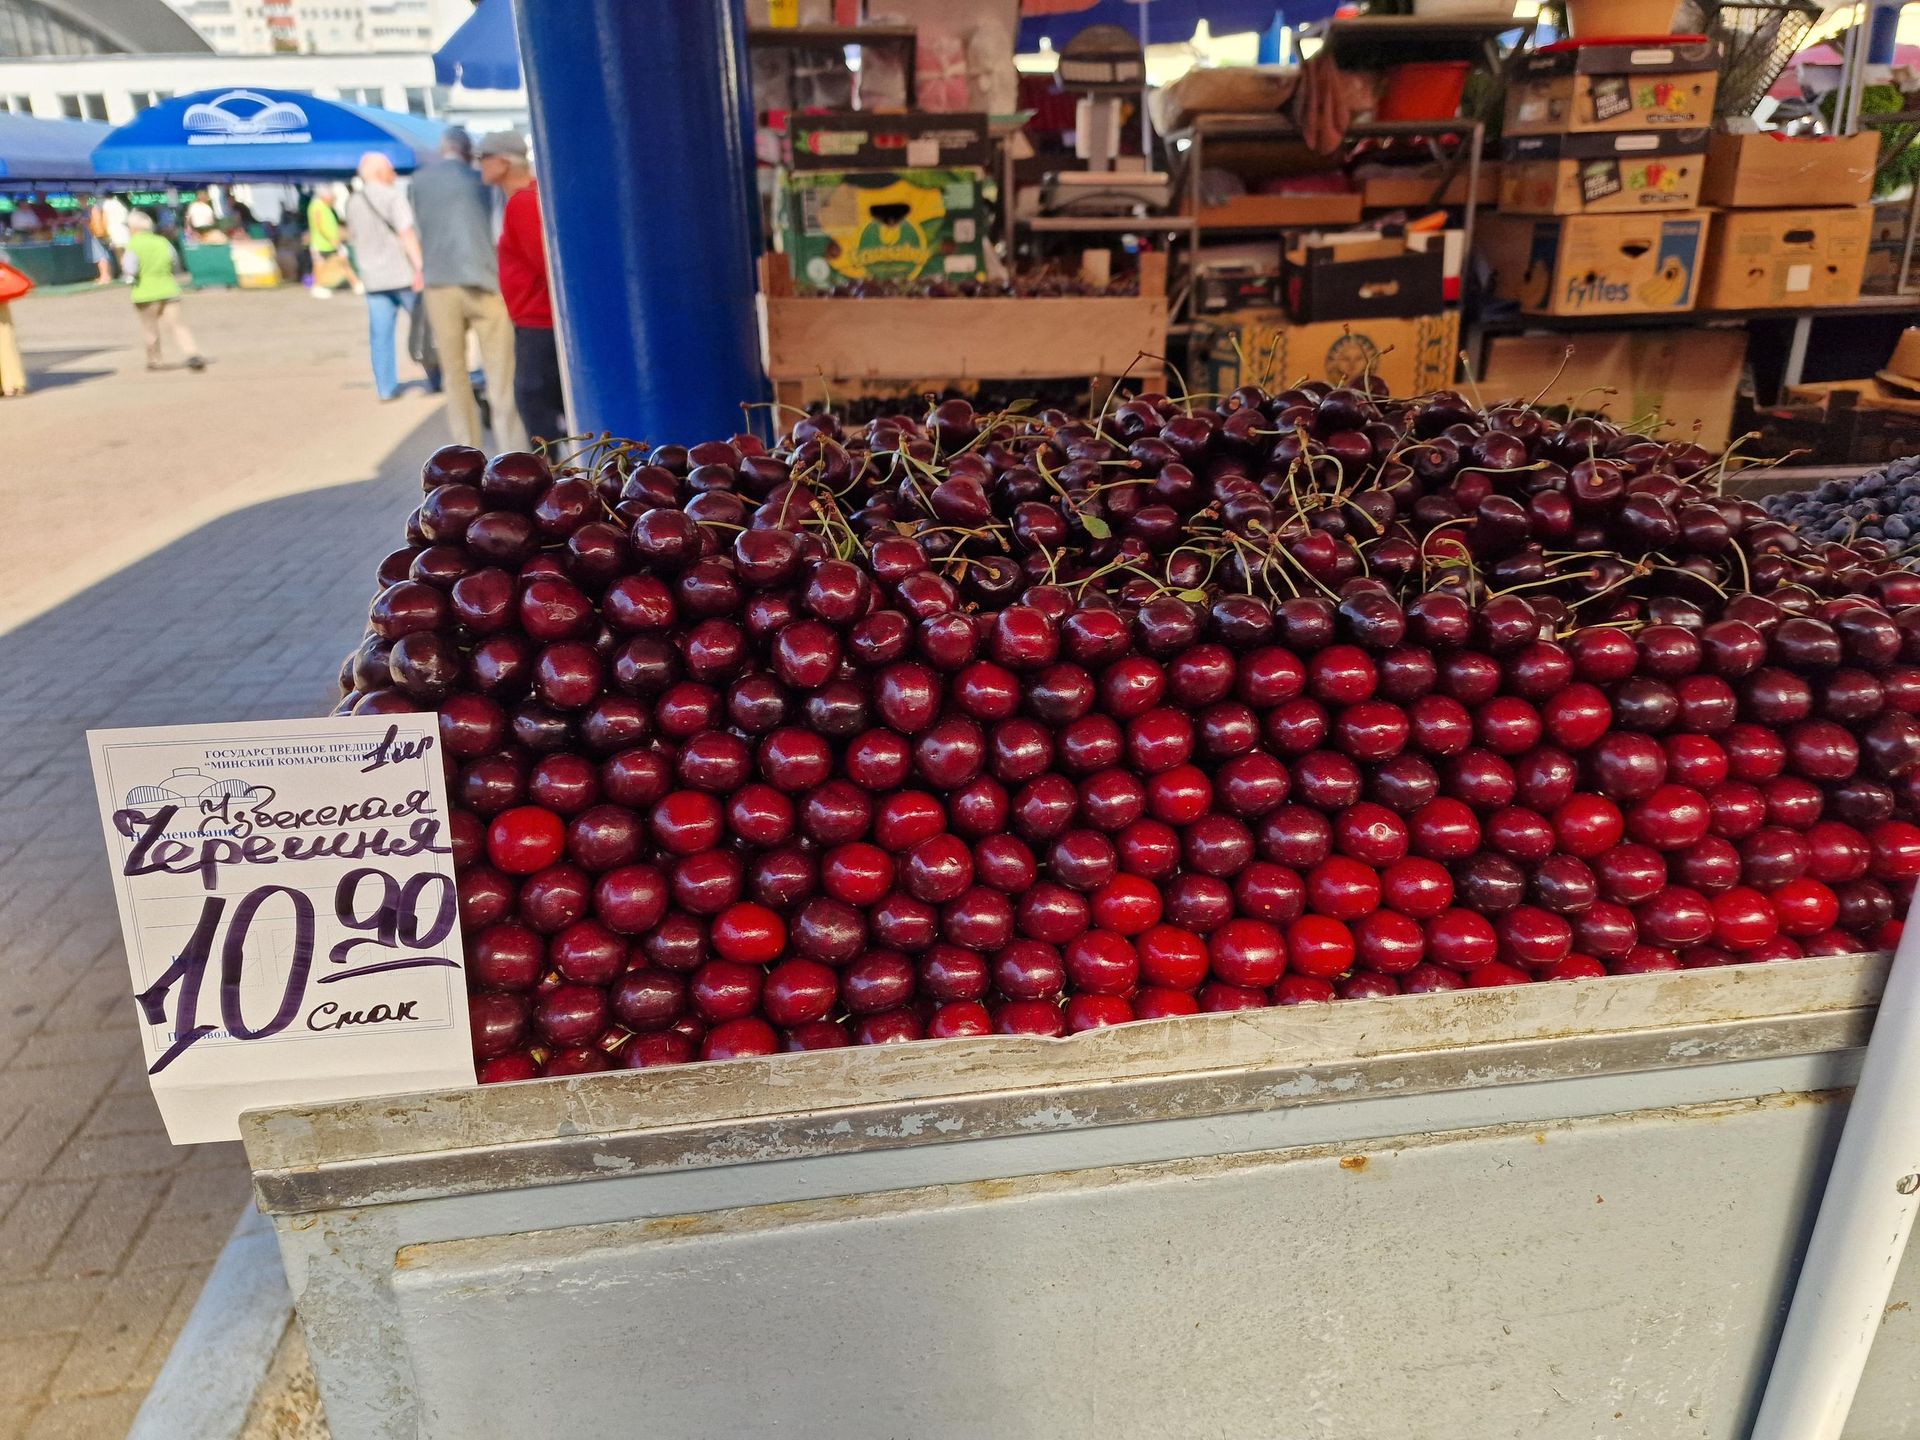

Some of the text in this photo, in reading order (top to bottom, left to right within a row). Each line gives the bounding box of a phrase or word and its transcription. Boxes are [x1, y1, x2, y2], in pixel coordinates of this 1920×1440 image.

[1567, 275, 1629, 307] fyffes
[205, 744, 326, 758] ГОСУДАРСТВЕННОЕ
[113, 805, 452, 890] Черешня
[135, 868, 457, 1075] 10 90
